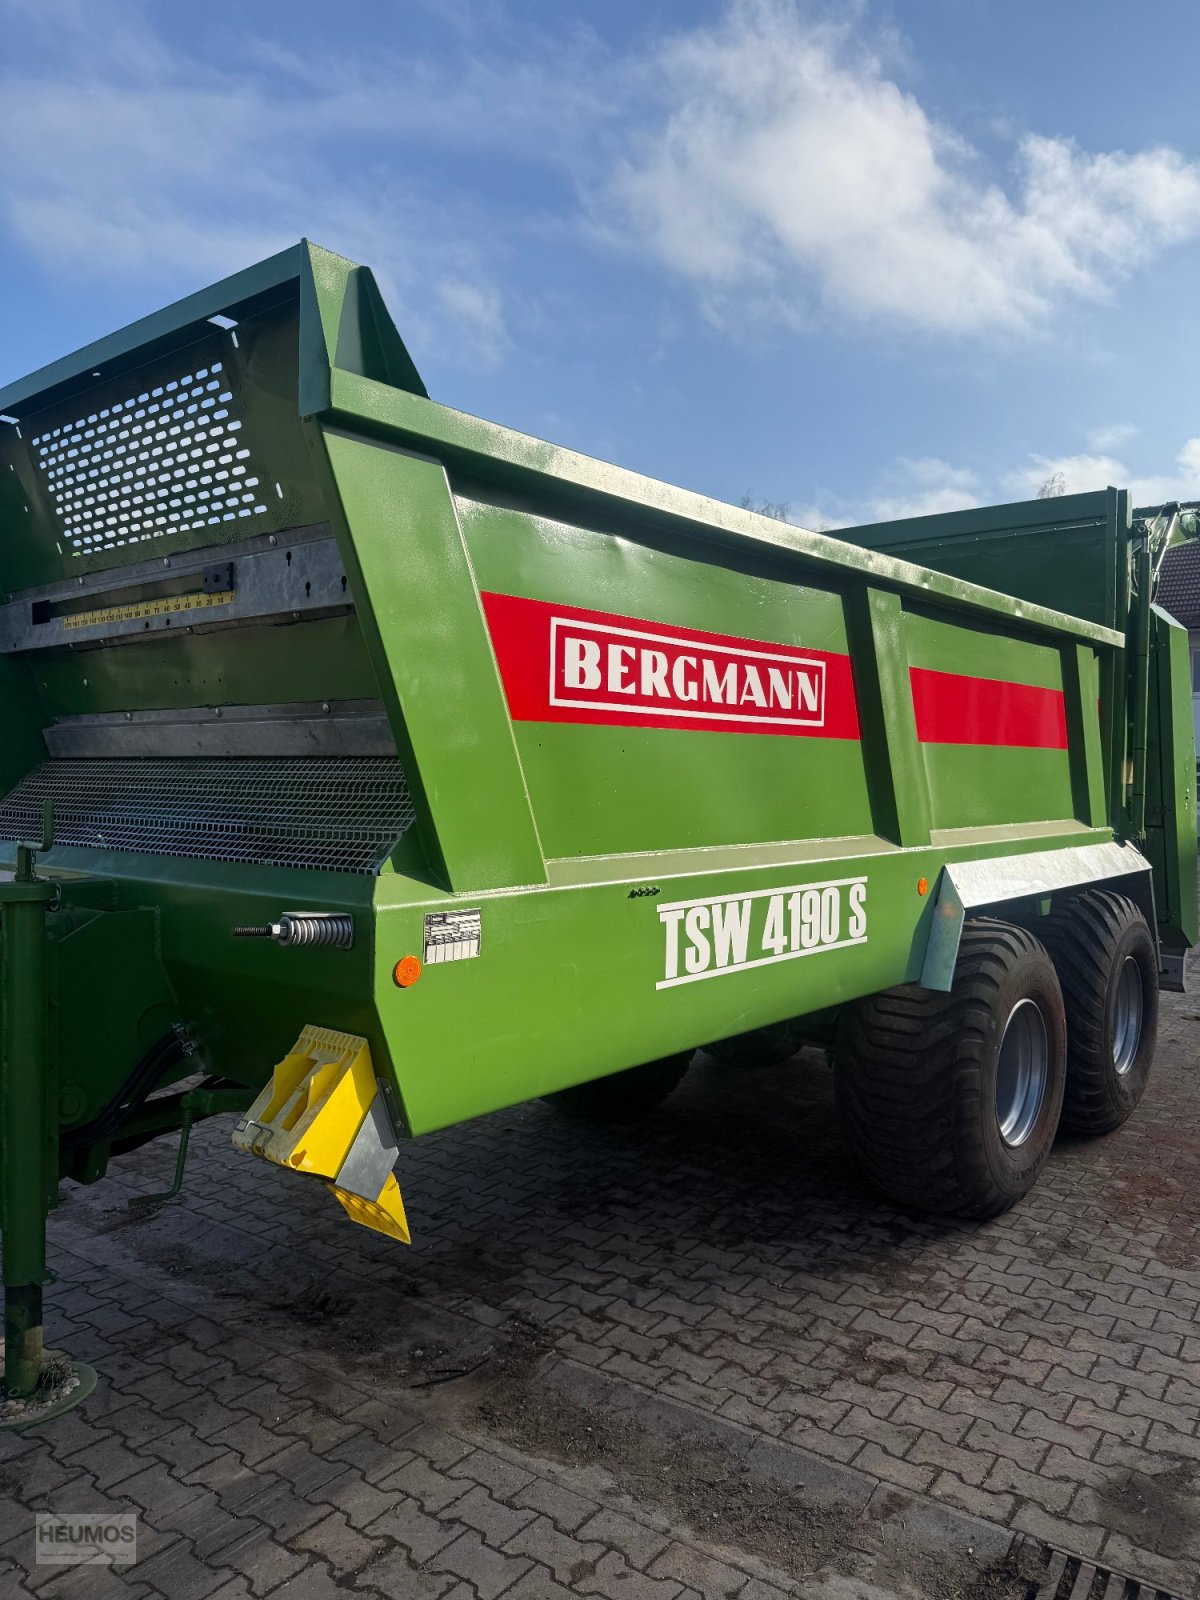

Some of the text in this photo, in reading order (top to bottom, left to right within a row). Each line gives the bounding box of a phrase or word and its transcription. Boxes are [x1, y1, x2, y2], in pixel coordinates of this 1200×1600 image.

[564, 637, 819, 712] BERGMANN
[659, 883, 867, 979] TSW 4190 S
